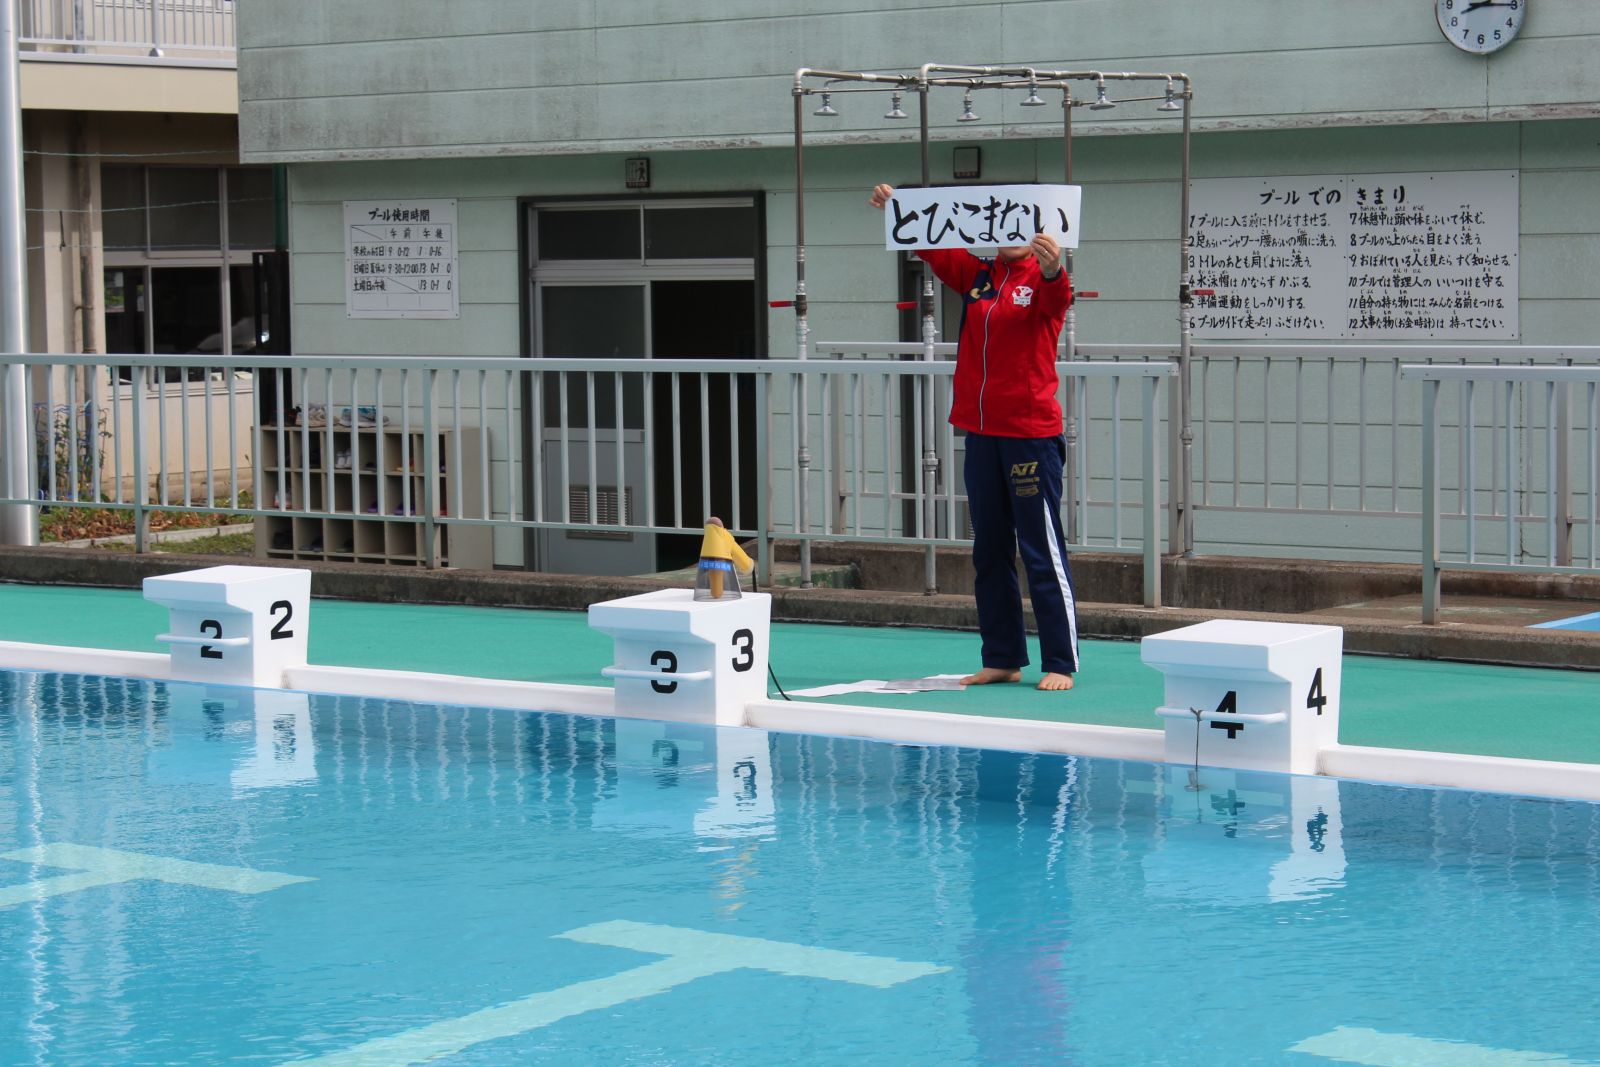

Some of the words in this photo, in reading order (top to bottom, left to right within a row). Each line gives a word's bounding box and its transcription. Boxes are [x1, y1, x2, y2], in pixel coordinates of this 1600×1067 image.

[1451, 17, 1458, 27] 8
[1462, 29, 1469, 39] 7
[1477, 34, 1485, 45] 6
[1493, 29, 1501, 40] 5
[1506, 17, 1513, 28] 4
[368, 207, 430, 222] プール使用時間
[892, 195, 1069, 245] とびこまない
[200, 619, 223, 660] 2
[269, 599, 294, 641] 2
[731, 628, 754, 673] 3
[650, 649, 678, 695] 3
[1306, 667, 1327, 716] 4
[1210, 690, 1245, 740] 4
